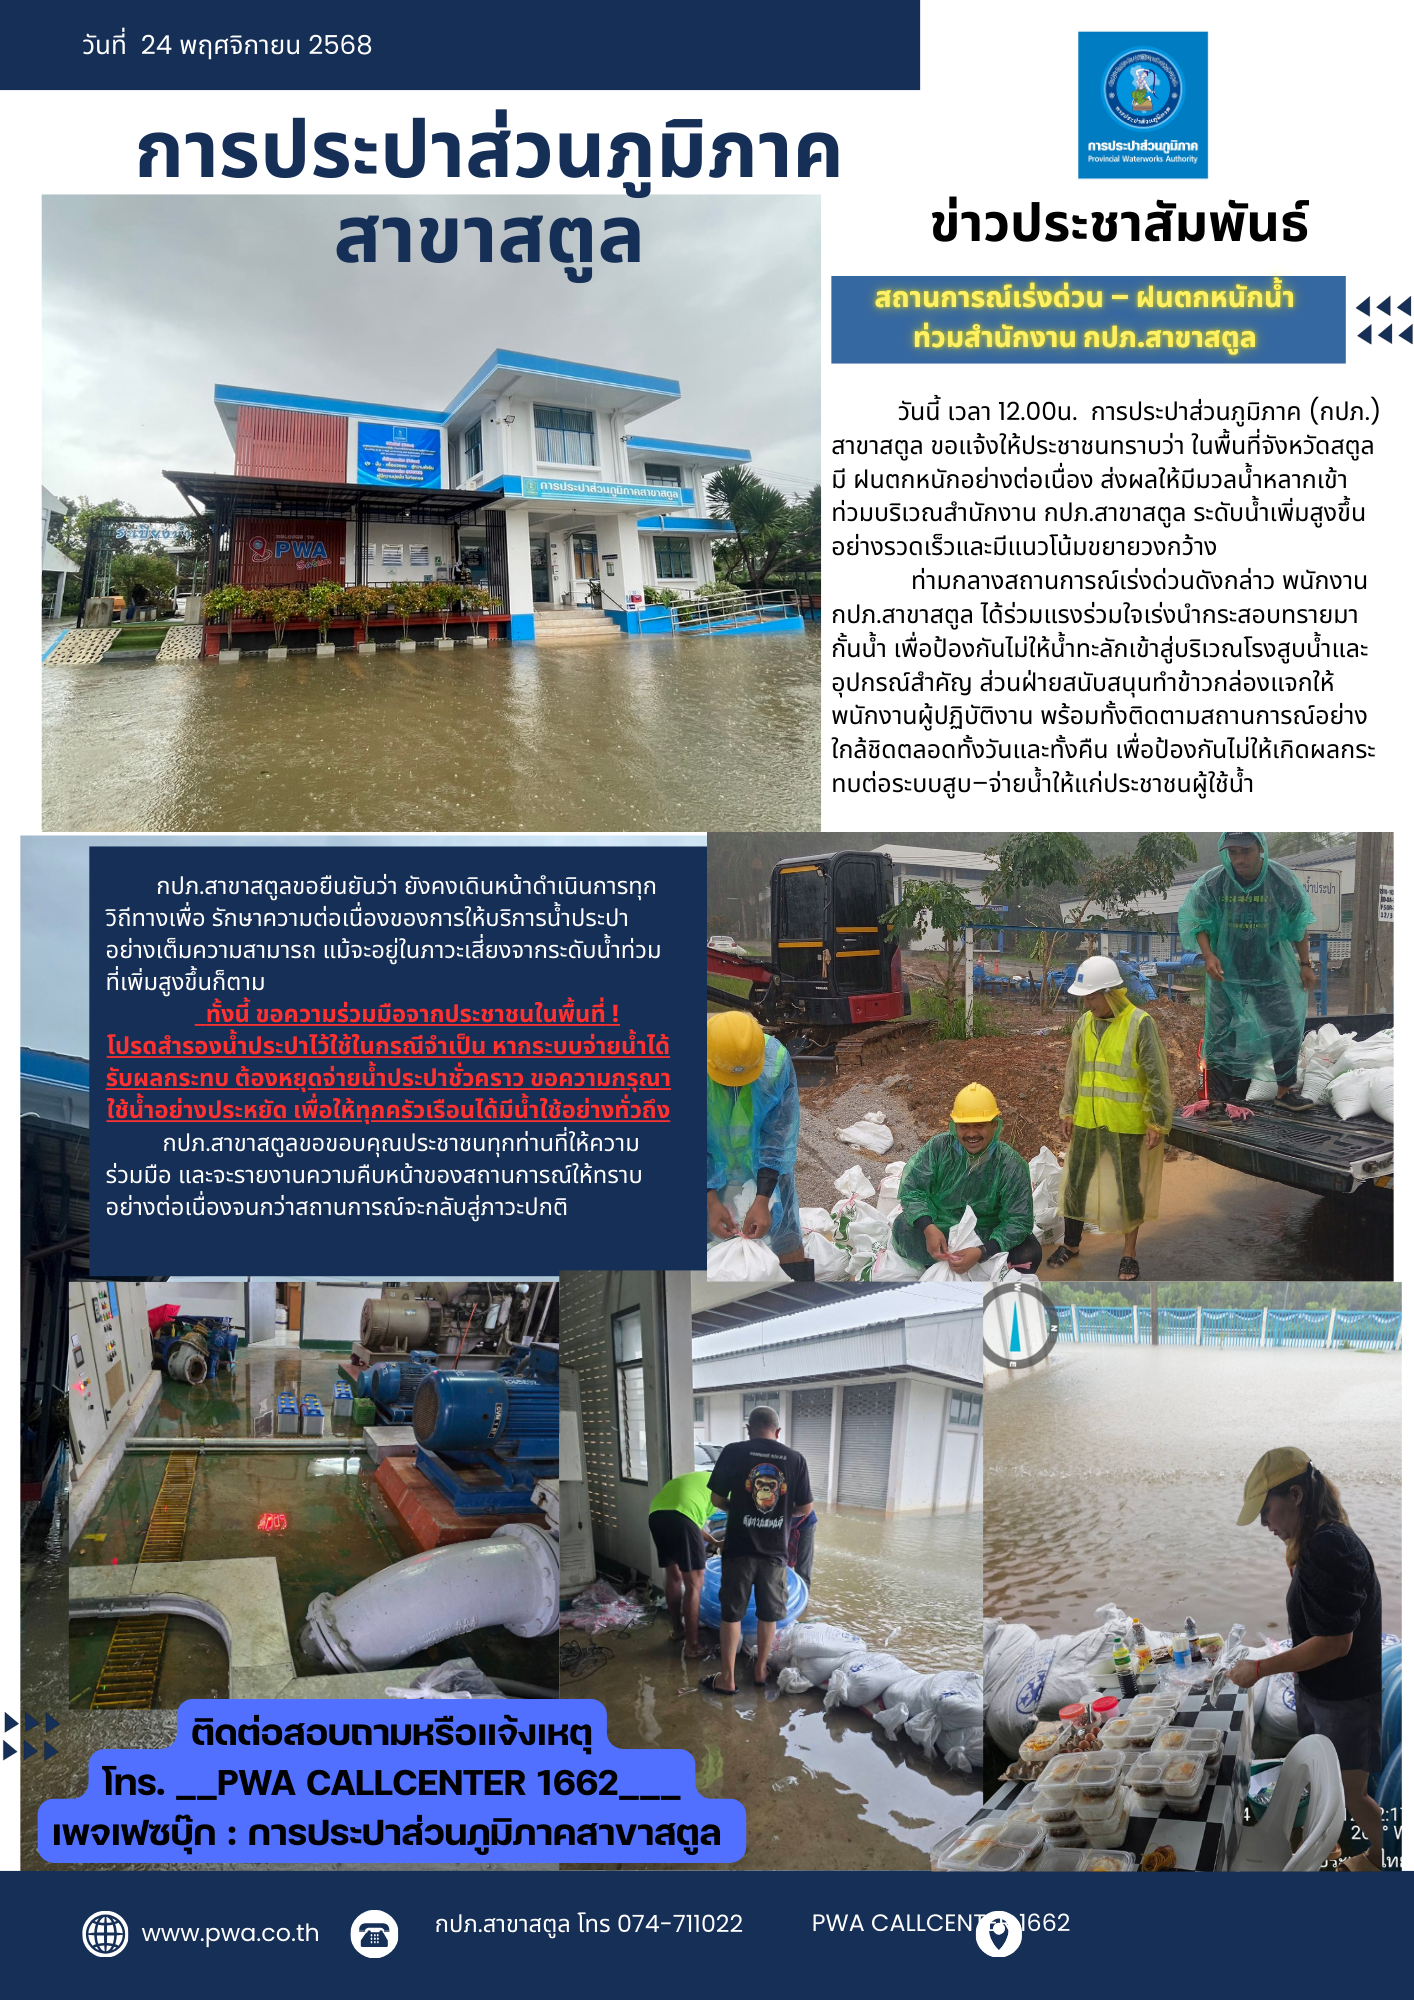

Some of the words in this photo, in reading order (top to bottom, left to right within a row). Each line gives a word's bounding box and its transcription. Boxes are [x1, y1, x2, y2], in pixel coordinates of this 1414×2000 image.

[540, 481, 679, 501] การประปาส่วนภูมิภาคสาขาสตูล
[275, 541, 328, 559] PWA
